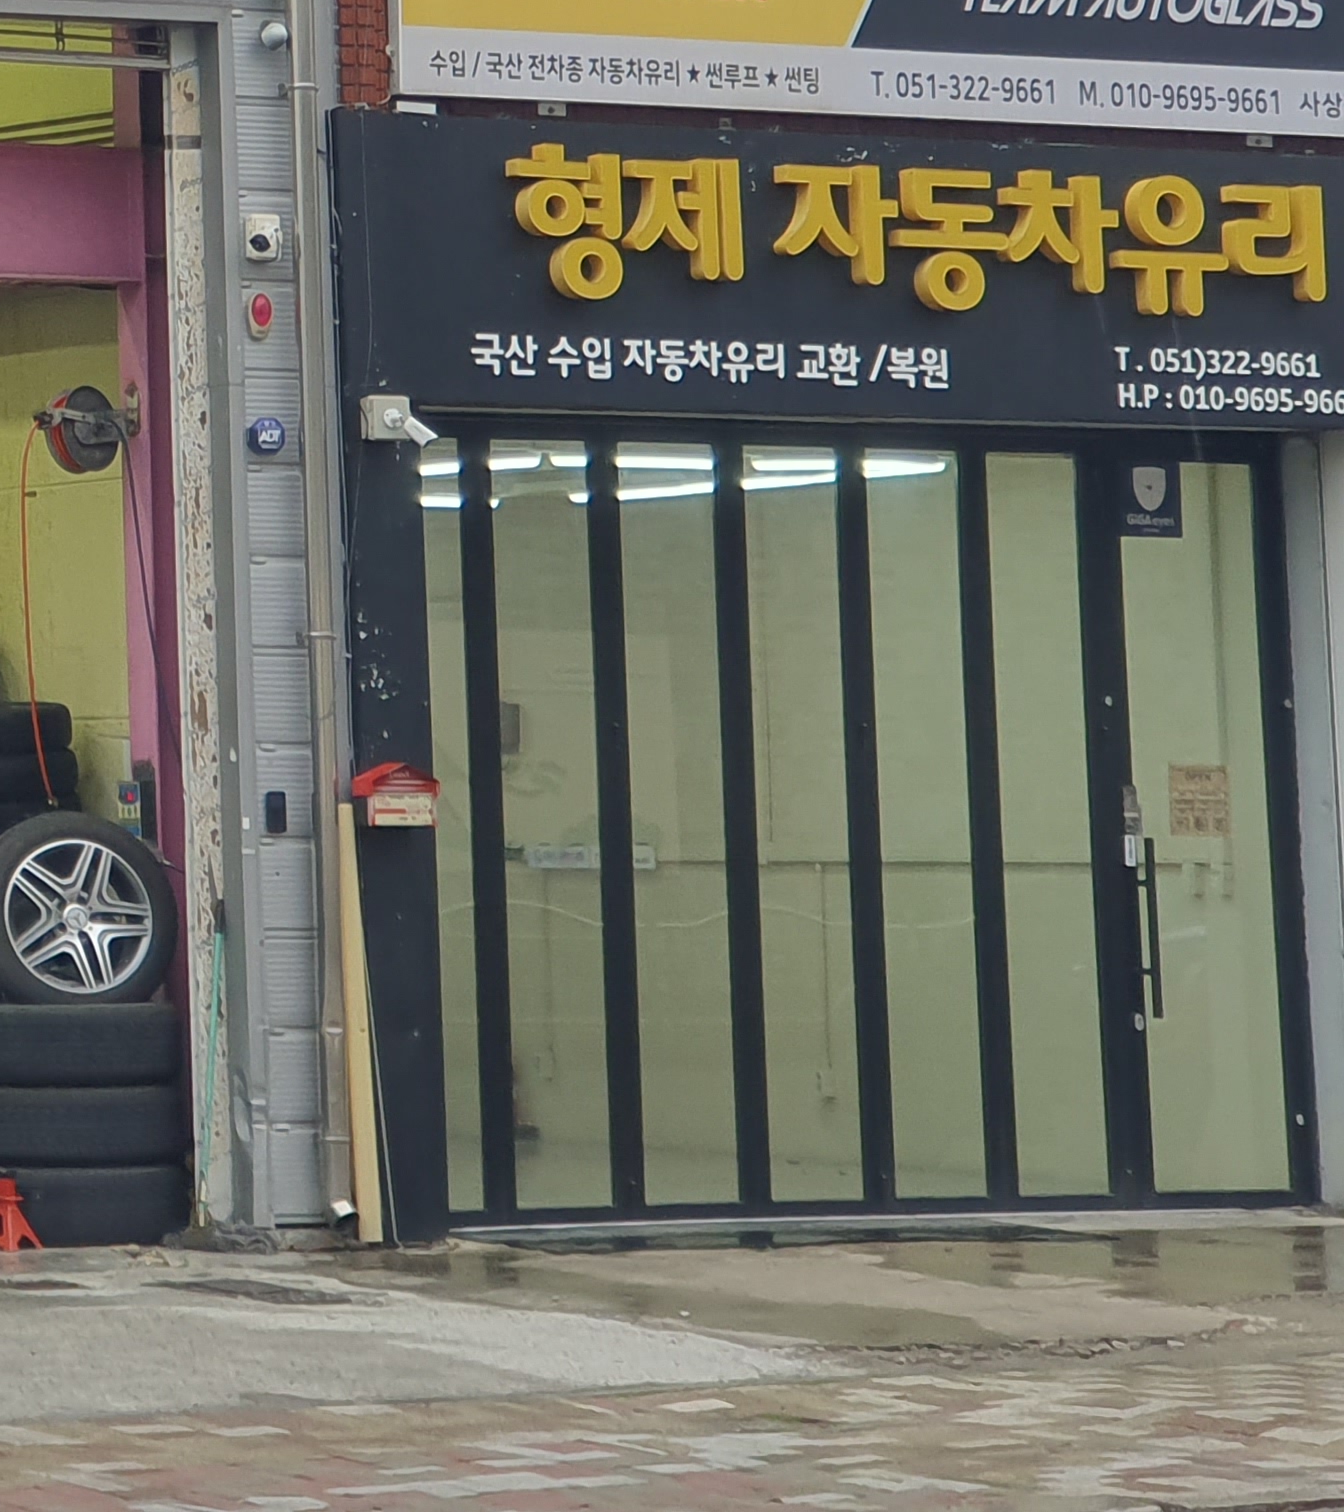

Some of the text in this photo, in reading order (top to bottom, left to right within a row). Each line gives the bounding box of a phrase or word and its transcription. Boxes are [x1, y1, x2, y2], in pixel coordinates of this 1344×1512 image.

[429, 49, 467, 78] 수입
[485, 51, 524, 81] 국산
[587, 54, 681, 88] 자동차유리
[705, 63, 761, 91] 썬루프
[784, 65, 821, 95] 썬팅
[505, 143, 1327, 318] 형제 자동차유리
[469, 332, 539, 376] 국산
[546, 335, 612, 380] 수입
[622, 336, 787, 384] 자동차유리
[795, 342, 861, 387] 교환
[258, 429, 281, 443] ADT
